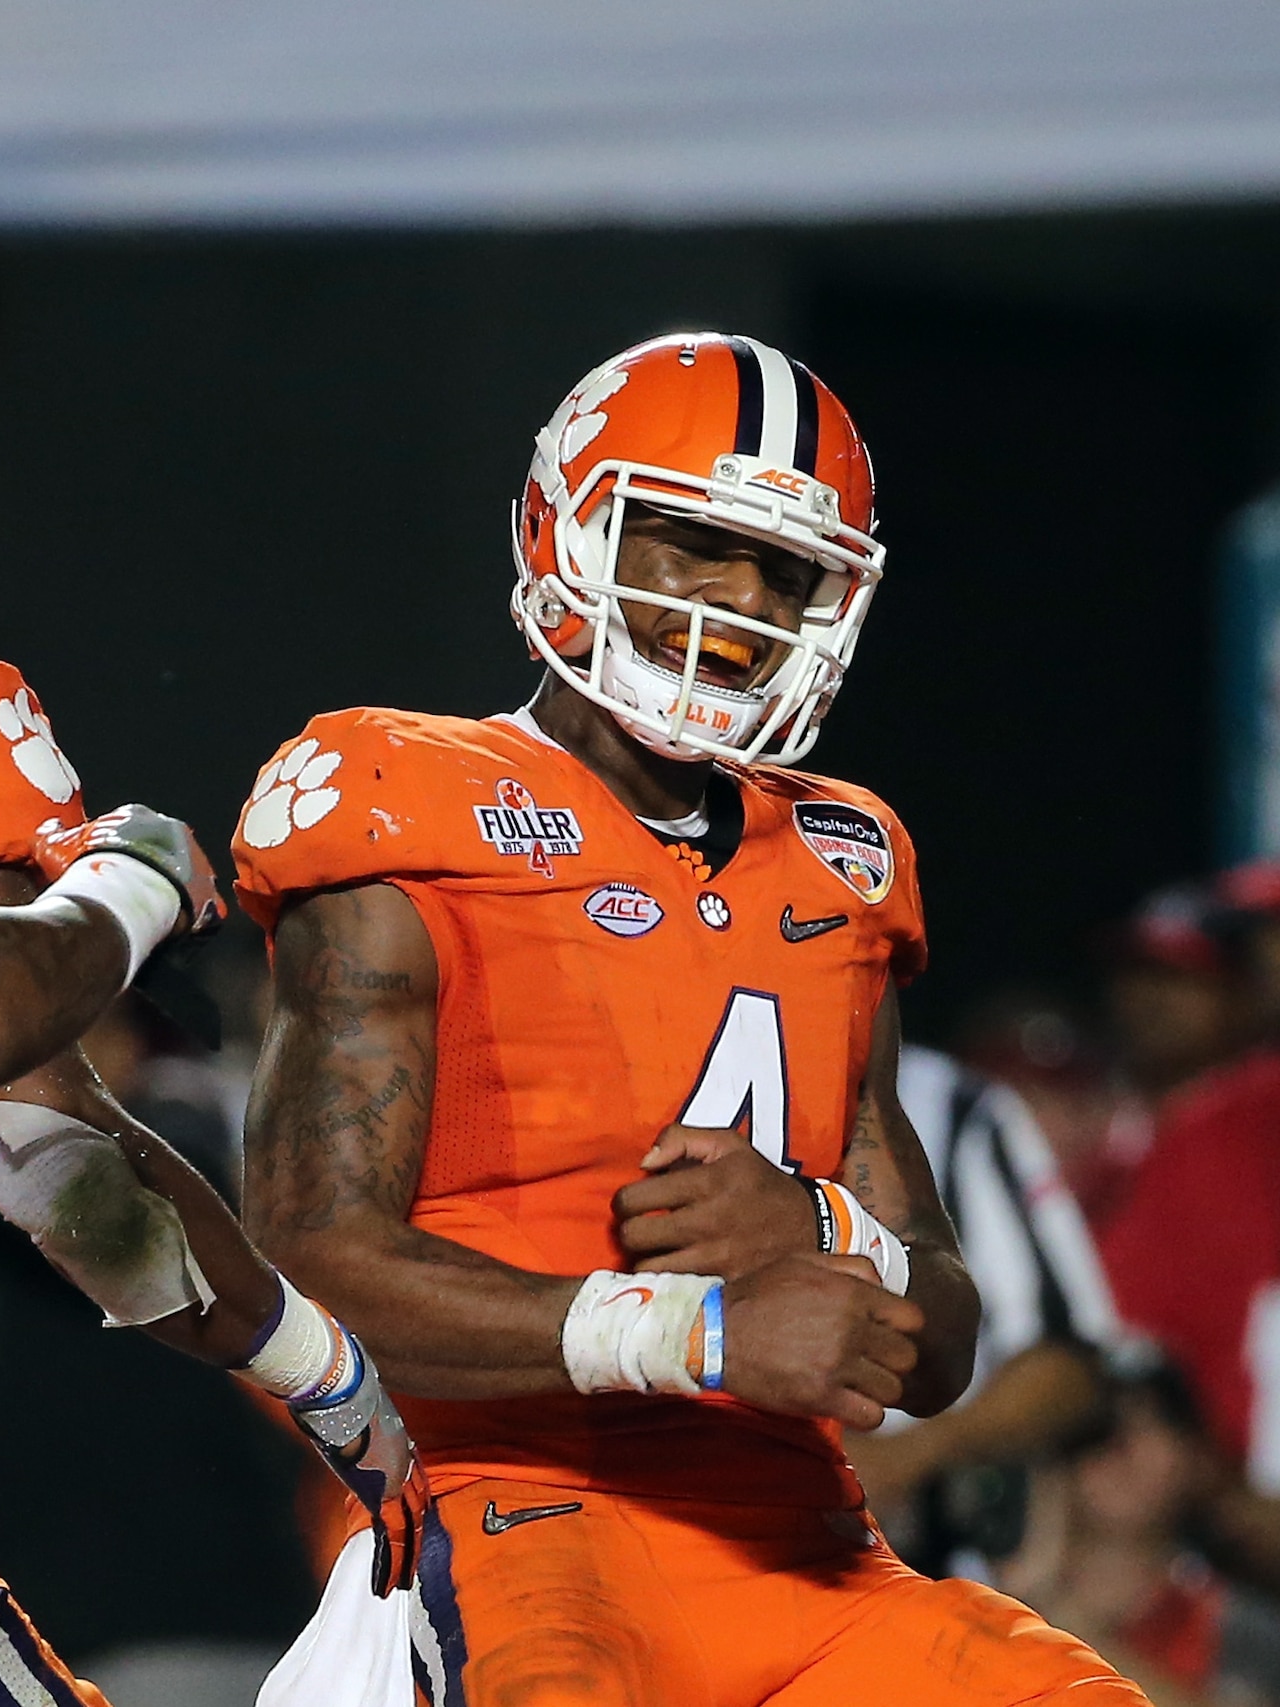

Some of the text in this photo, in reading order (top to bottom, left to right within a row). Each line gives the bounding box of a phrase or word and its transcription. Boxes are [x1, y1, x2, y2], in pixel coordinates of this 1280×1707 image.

[751, 468, 808, 495] ACC
[711, 709, 732, 732] IN
[480, 808, 577, 840] FULLER
[501, 841, 525, 854] 1975
[531, 839, 553, 877] 4
[595, 897, 652, 918] ACC
[677, 985, 803, 1177] 4
[822, 1219, 833, 1249] Light
